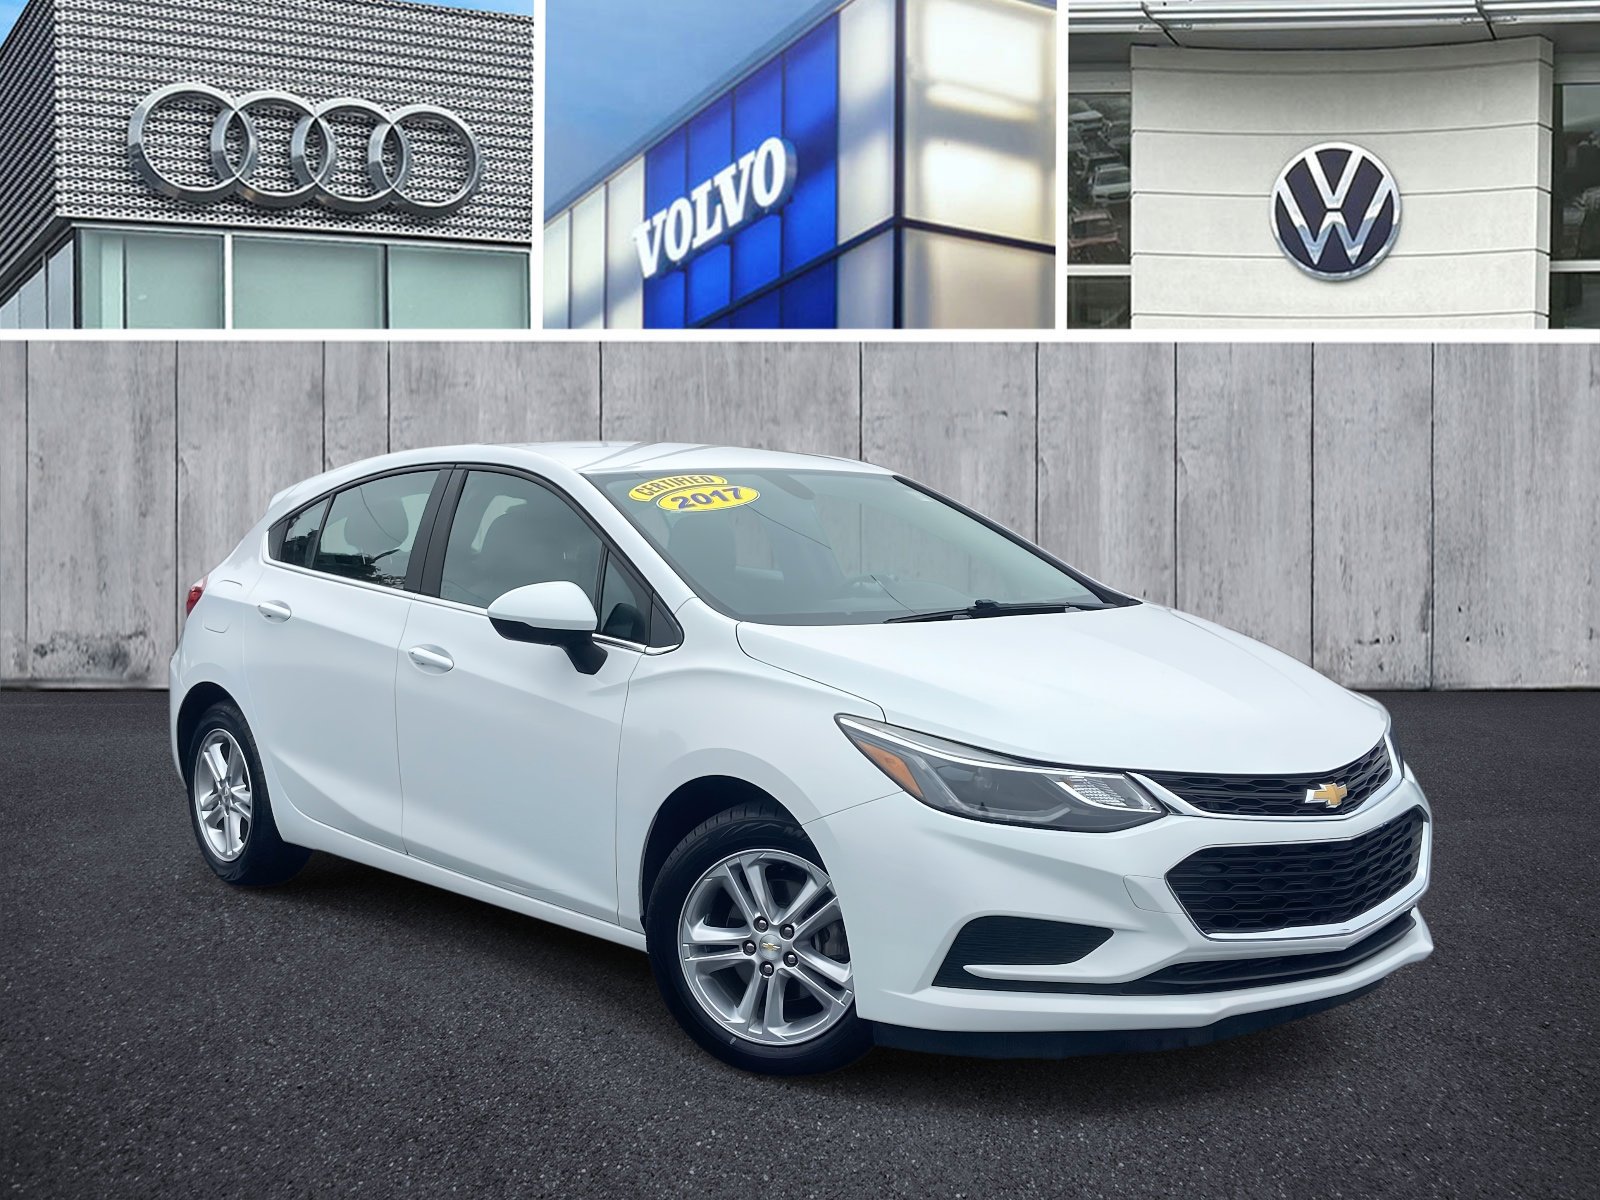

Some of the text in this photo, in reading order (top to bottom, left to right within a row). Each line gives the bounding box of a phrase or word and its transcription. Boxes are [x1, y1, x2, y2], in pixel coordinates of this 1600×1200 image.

[633, 137, 790, 279] VOLVO
[635, 475, 713, 496] CERTIFIED
[671, 487, 743, 510] 2017
